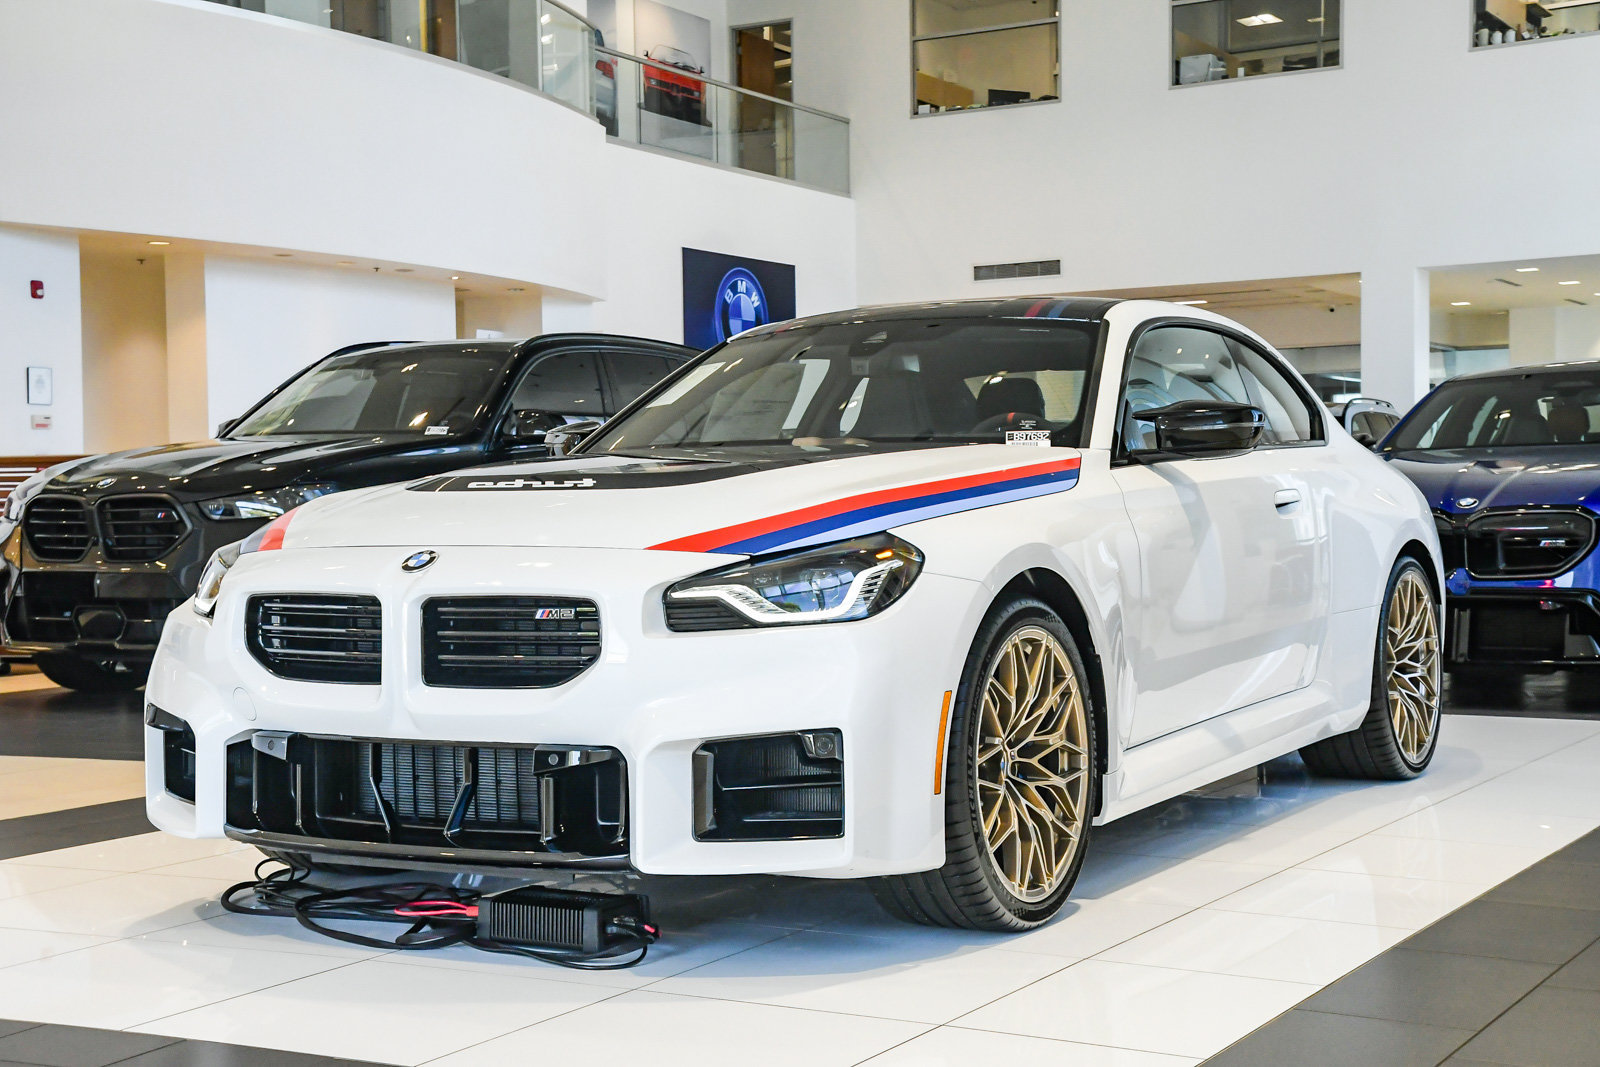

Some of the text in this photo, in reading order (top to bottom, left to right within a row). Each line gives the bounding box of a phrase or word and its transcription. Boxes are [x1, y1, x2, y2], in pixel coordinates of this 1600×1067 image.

[724, 280, 760, 308] BMW
[544, 608, 575, 619] M2
[967, 745, 978, 833] MICHELIN
